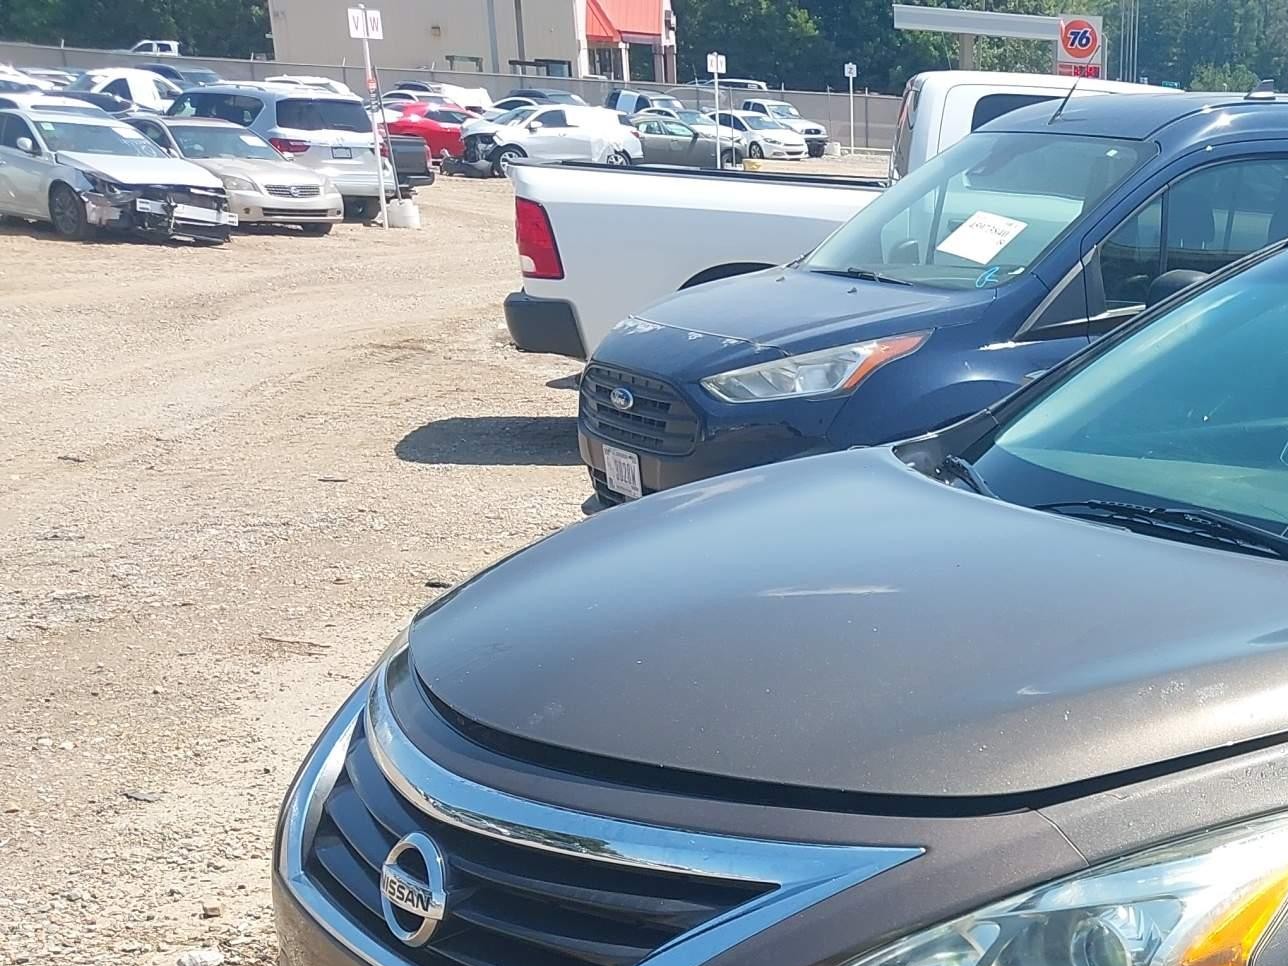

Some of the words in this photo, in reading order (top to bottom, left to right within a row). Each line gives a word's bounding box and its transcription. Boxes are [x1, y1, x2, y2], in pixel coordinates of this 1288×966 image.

[352, 15, 359, 31] V
[369, 16, 379, 32] W
[1067, 28, 1093, 49] 76
